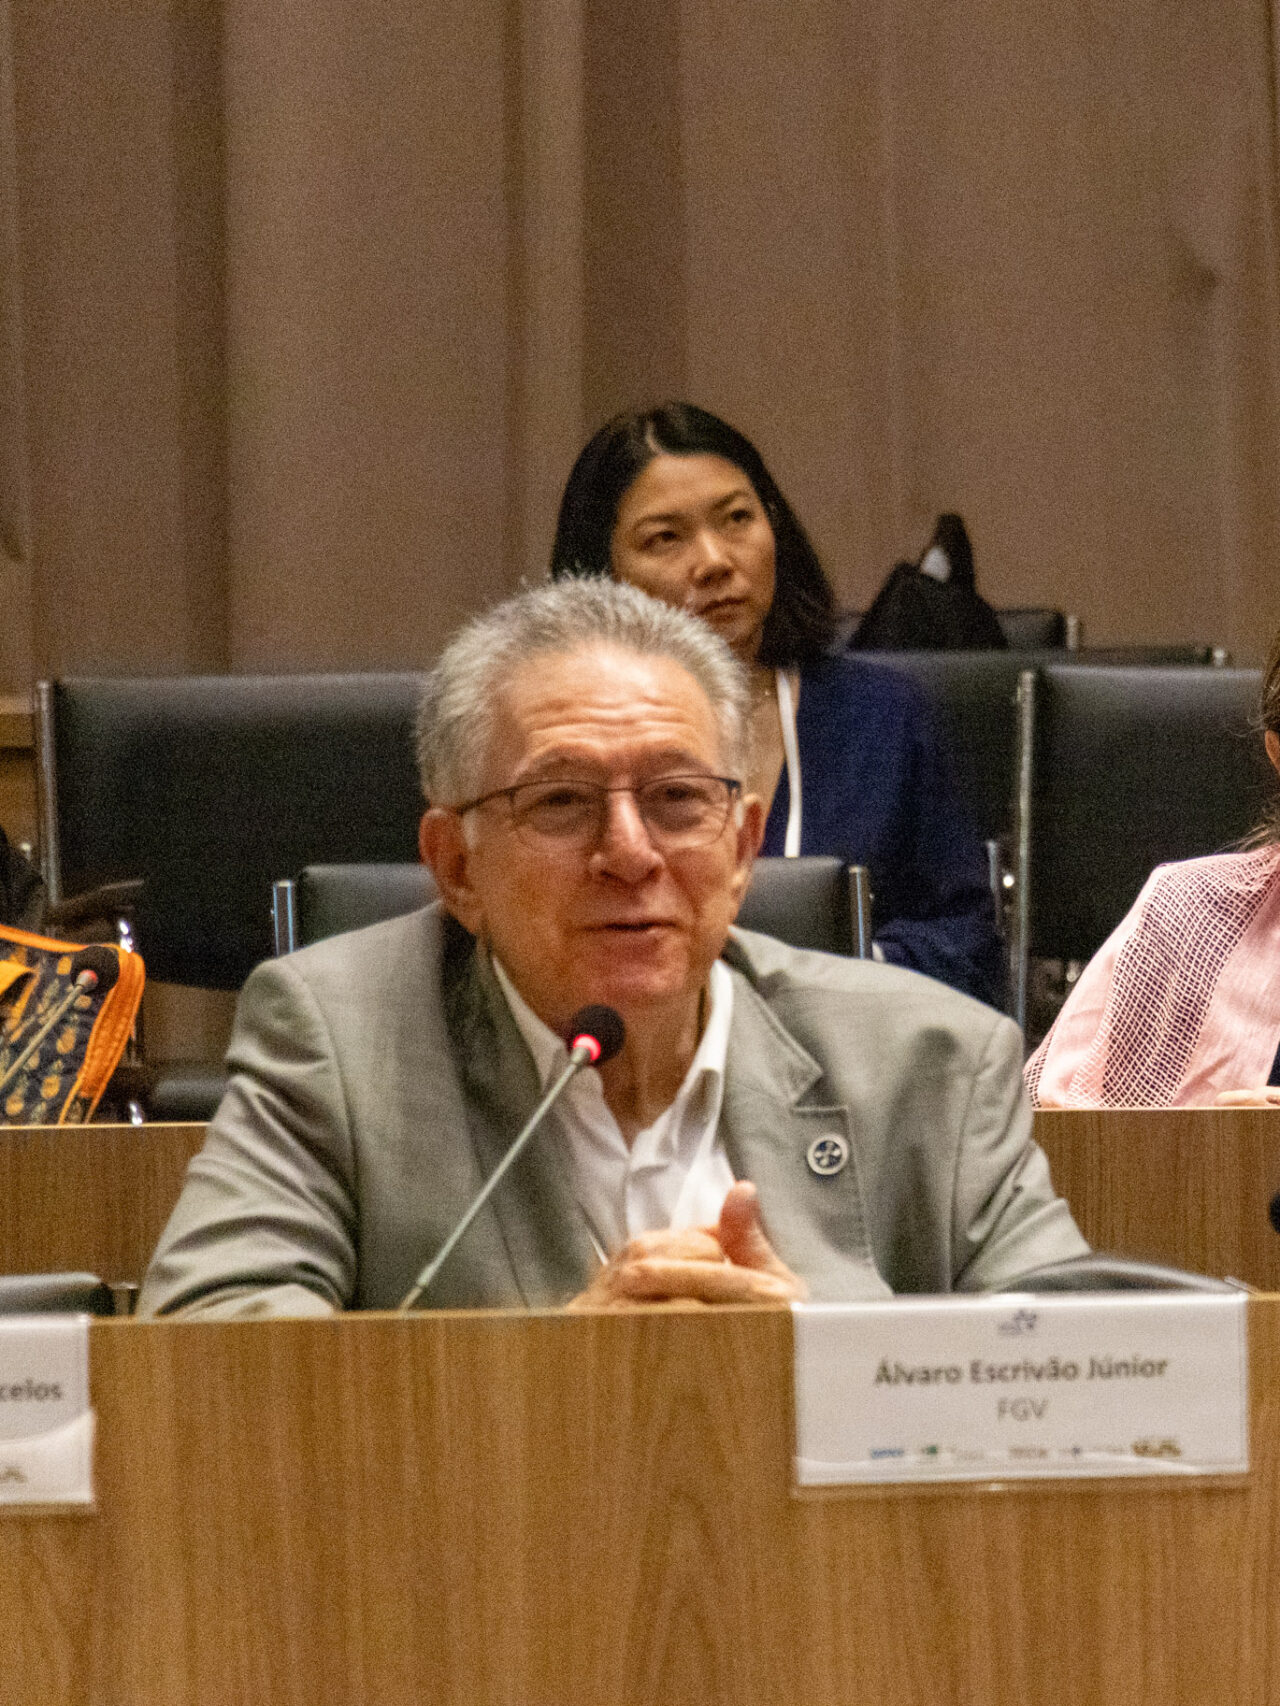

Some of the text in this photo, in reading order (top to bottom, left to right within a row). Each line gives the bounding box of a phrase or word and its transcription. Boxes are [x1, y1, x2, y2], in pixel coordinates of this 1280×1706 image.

[874, 1354, 1168, 1385] Álvaro Escrivão Júnior
[999, 1399, 1048, 1421] FGV
